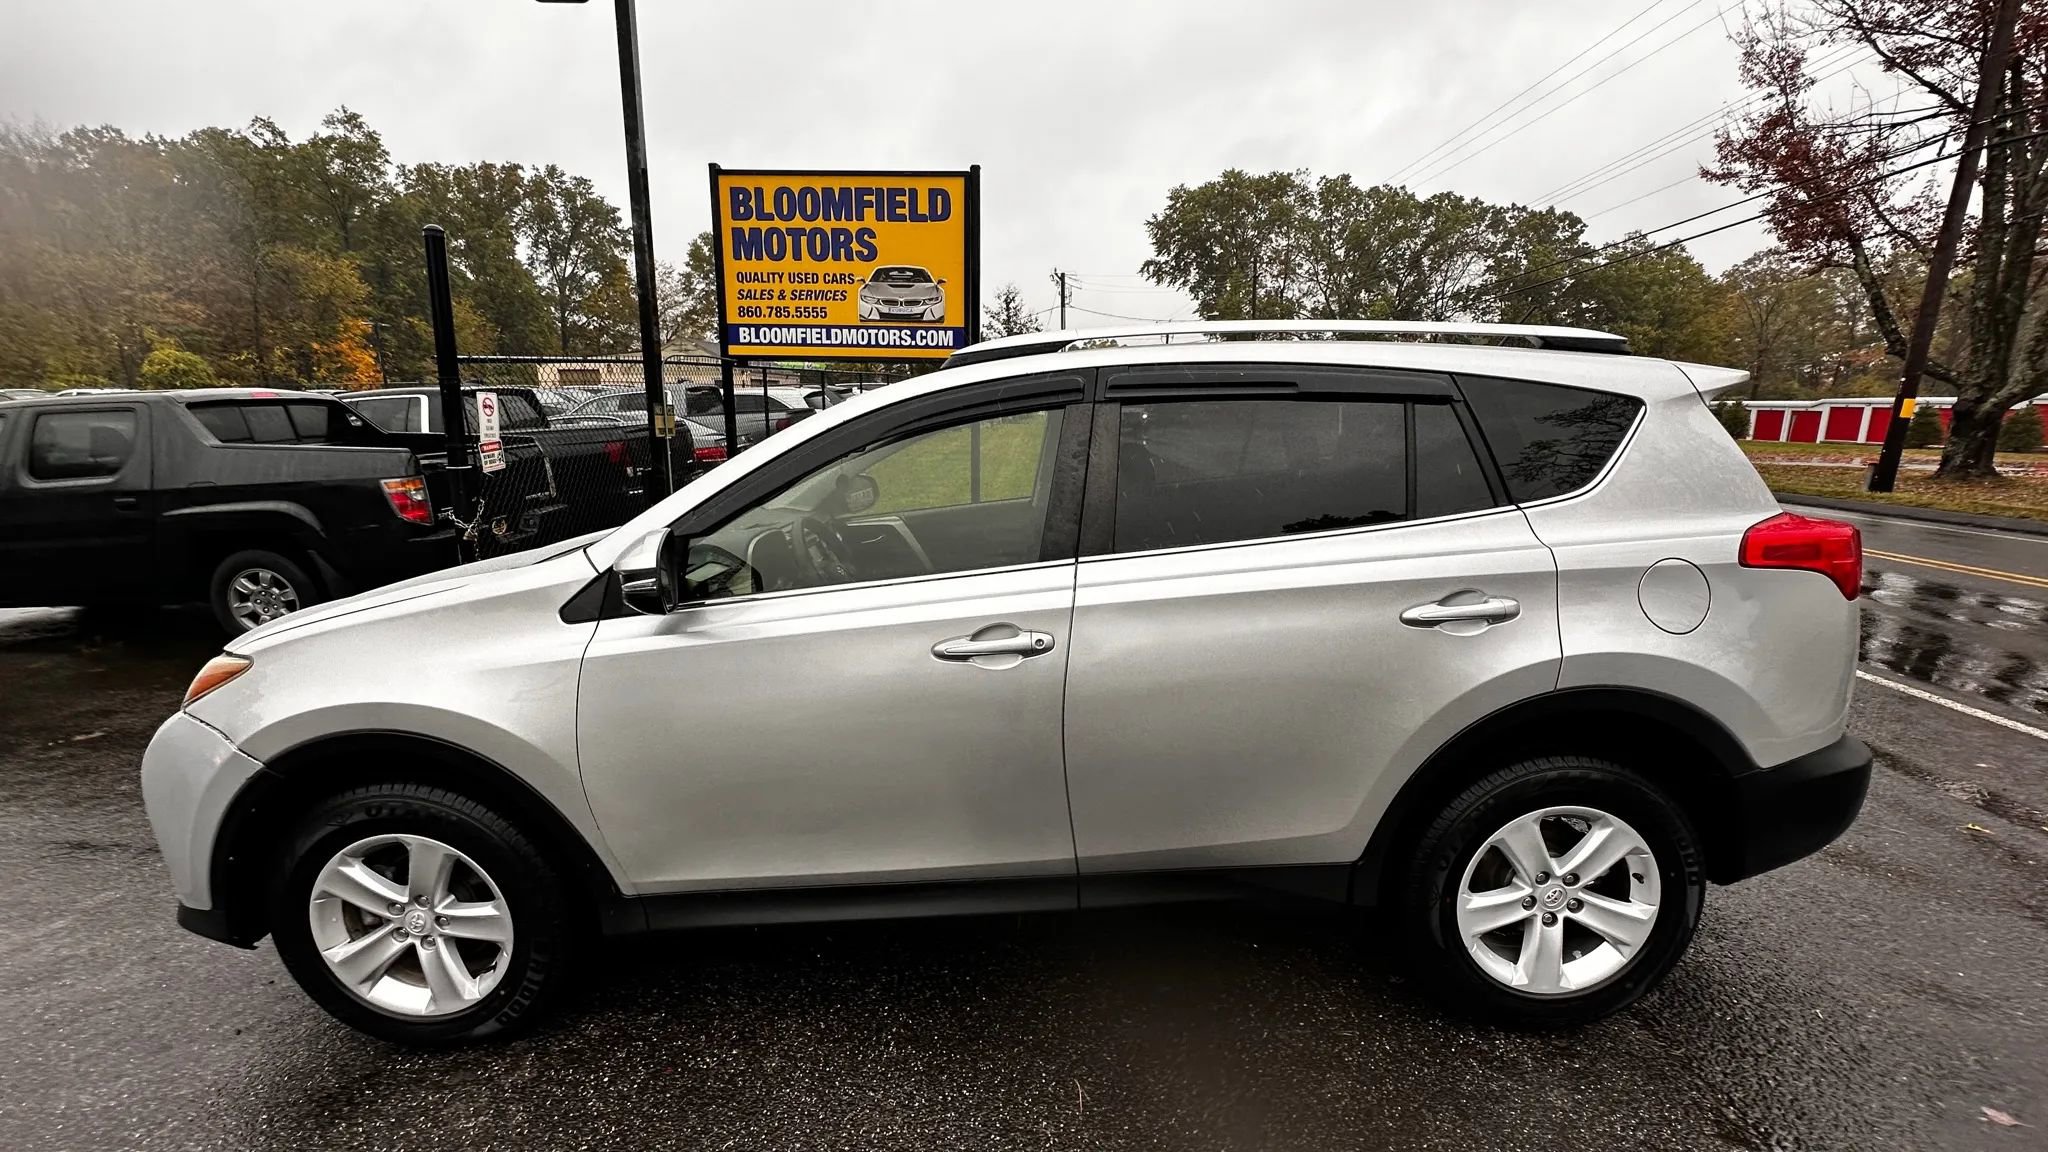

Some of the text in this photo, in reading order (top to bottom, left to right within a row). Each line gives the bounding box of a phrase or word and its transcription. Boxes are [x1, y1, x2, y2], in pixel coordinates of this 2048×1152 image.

[730, 186, 952, 222] BLOOMFIELD
[732, 227, 878, 262] MOTORS
[736, 271, 855, 285] QUALITY USED CARS
[737, 289, 848, 302] SALES & SERVICES
[737, 306, 828, 319] 860.785.5555
[739, 327, 954, 347] BLOOMFIELDMOTORS.COM
